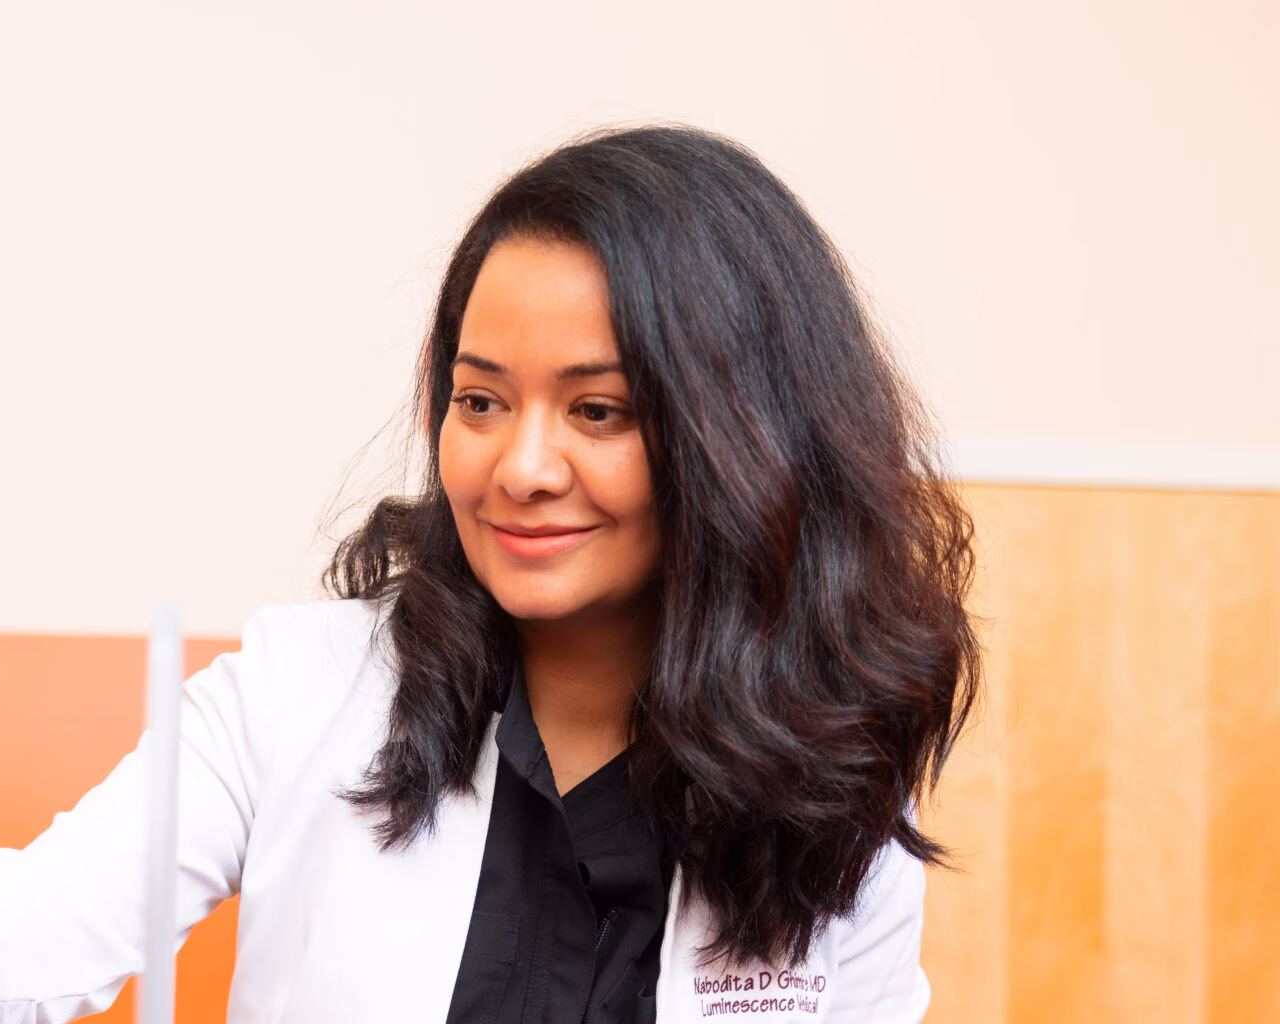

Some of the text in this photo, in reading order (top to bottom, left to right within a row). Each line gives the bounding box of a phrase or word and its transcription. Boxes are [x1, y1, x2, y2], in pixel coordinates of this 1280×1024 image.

[694, 974, 754, 995] Nabodita
[759, 971, 772, 990] D
[809, 974, 826, 993] MD
[701, 997, 795, 1017] Luminescence
